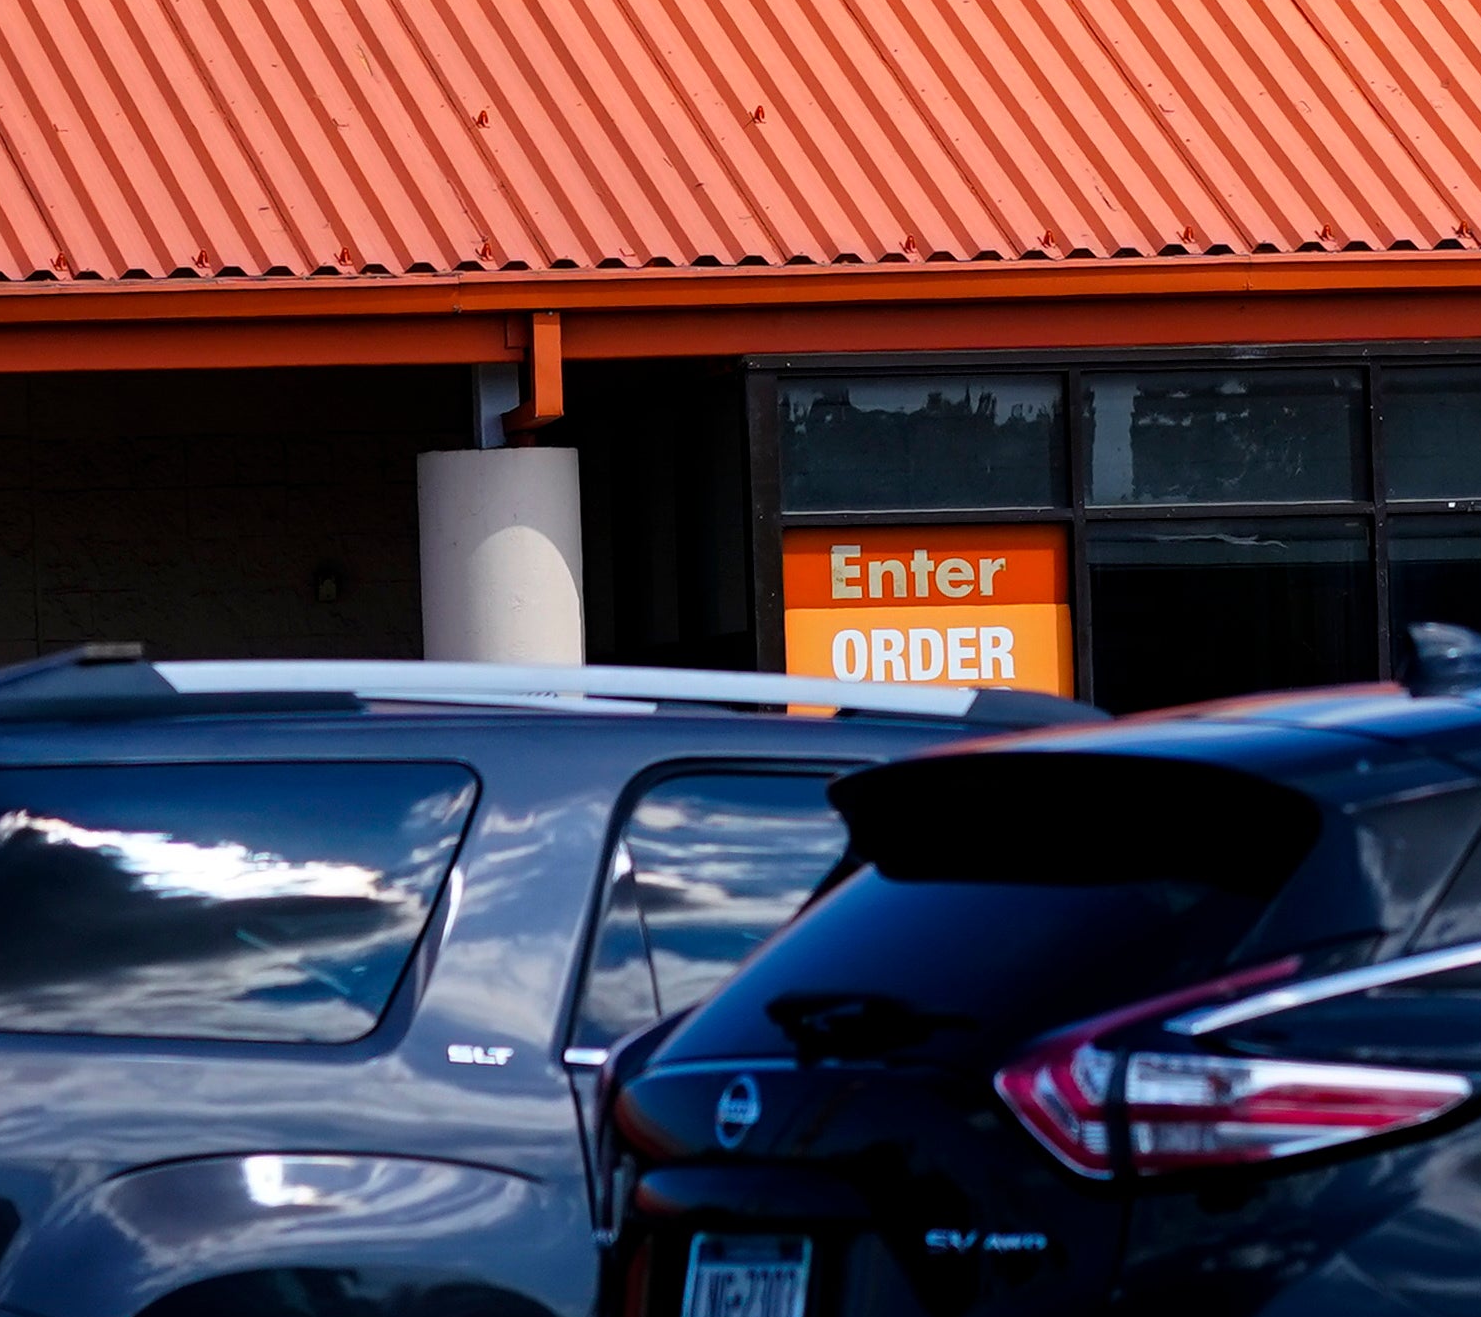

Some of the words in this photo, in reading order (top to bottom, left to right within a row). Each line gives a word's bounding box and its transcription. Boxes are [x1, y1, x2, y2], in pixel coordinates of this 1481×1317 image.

[830, 544, 1007, 600] Enter
[831, 626, 1016, 684] ORDER
[447, 1043, 515, 1066] SLT
